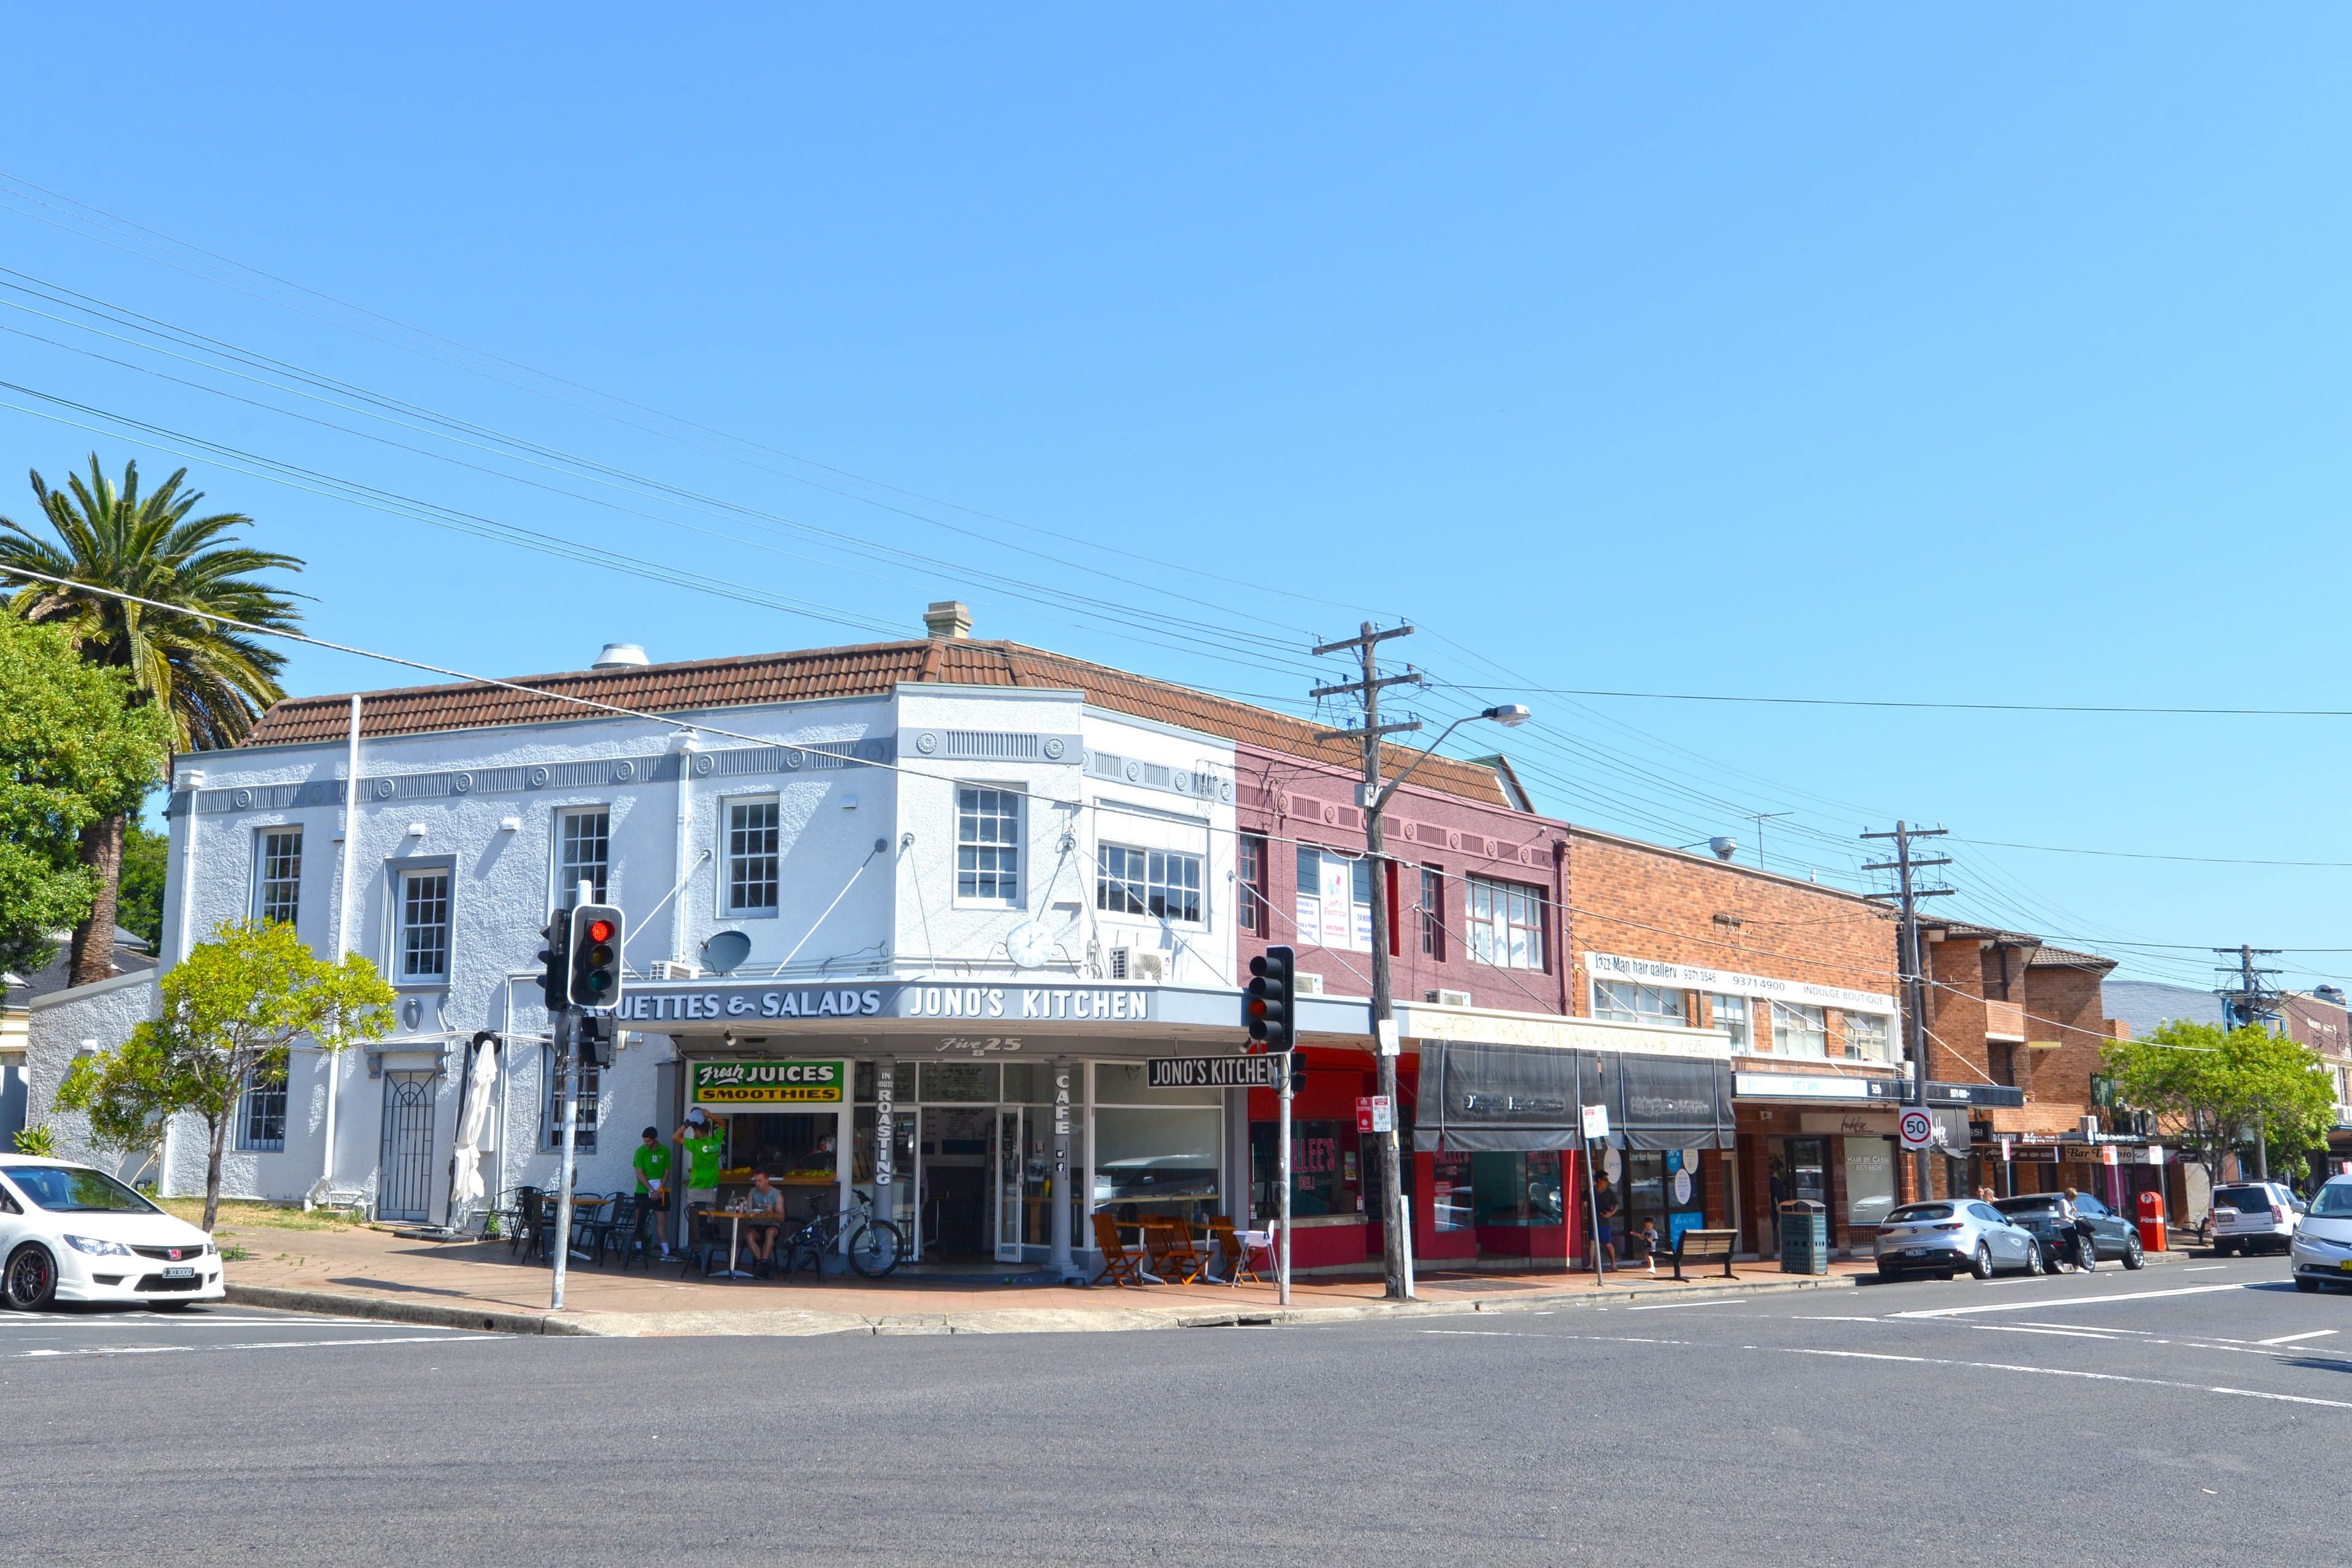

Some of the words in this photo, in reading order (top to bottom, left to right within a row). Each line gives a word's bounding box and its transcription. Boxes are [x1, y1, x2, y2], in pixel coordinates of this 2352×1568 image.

[1613, 956, 1630, 973] Man
[1633, 959, 1648, 974] hair
[760, 990, 880, 1017] SALADS
[910, 987, 1005, 1017] JONO'S
[1023, 989, 1148, 1019] KITCHEN
[1803, 986, 1840, 998] INDULGE
[1843, 991, 1884, 1005] BOUTIQUE
[935, 1038, 981, 1052] Five
[982, 1038, 1022, 1051] 25
[699, 1064, 744, 1085] Fresh
[747, 1066, 834, 1082] JUICES
[1153, 1060, 1207, 1084] JONO'S
[1212, 1058, 1277, 1084] KITCHEN
[703, 1090, 835, 1099] SMOOTHIES
[1055, 1075, 1069, 1134] CAFE
[1906, 1121, 1926, 1134] 50
[876, 1090, 892, 1185] ROASTING
[2067, 1148, 2090, 1158] Bar
[1298, 1176, 1316, 1190] DELI
[167, 1268, 192, 1276] 303000
